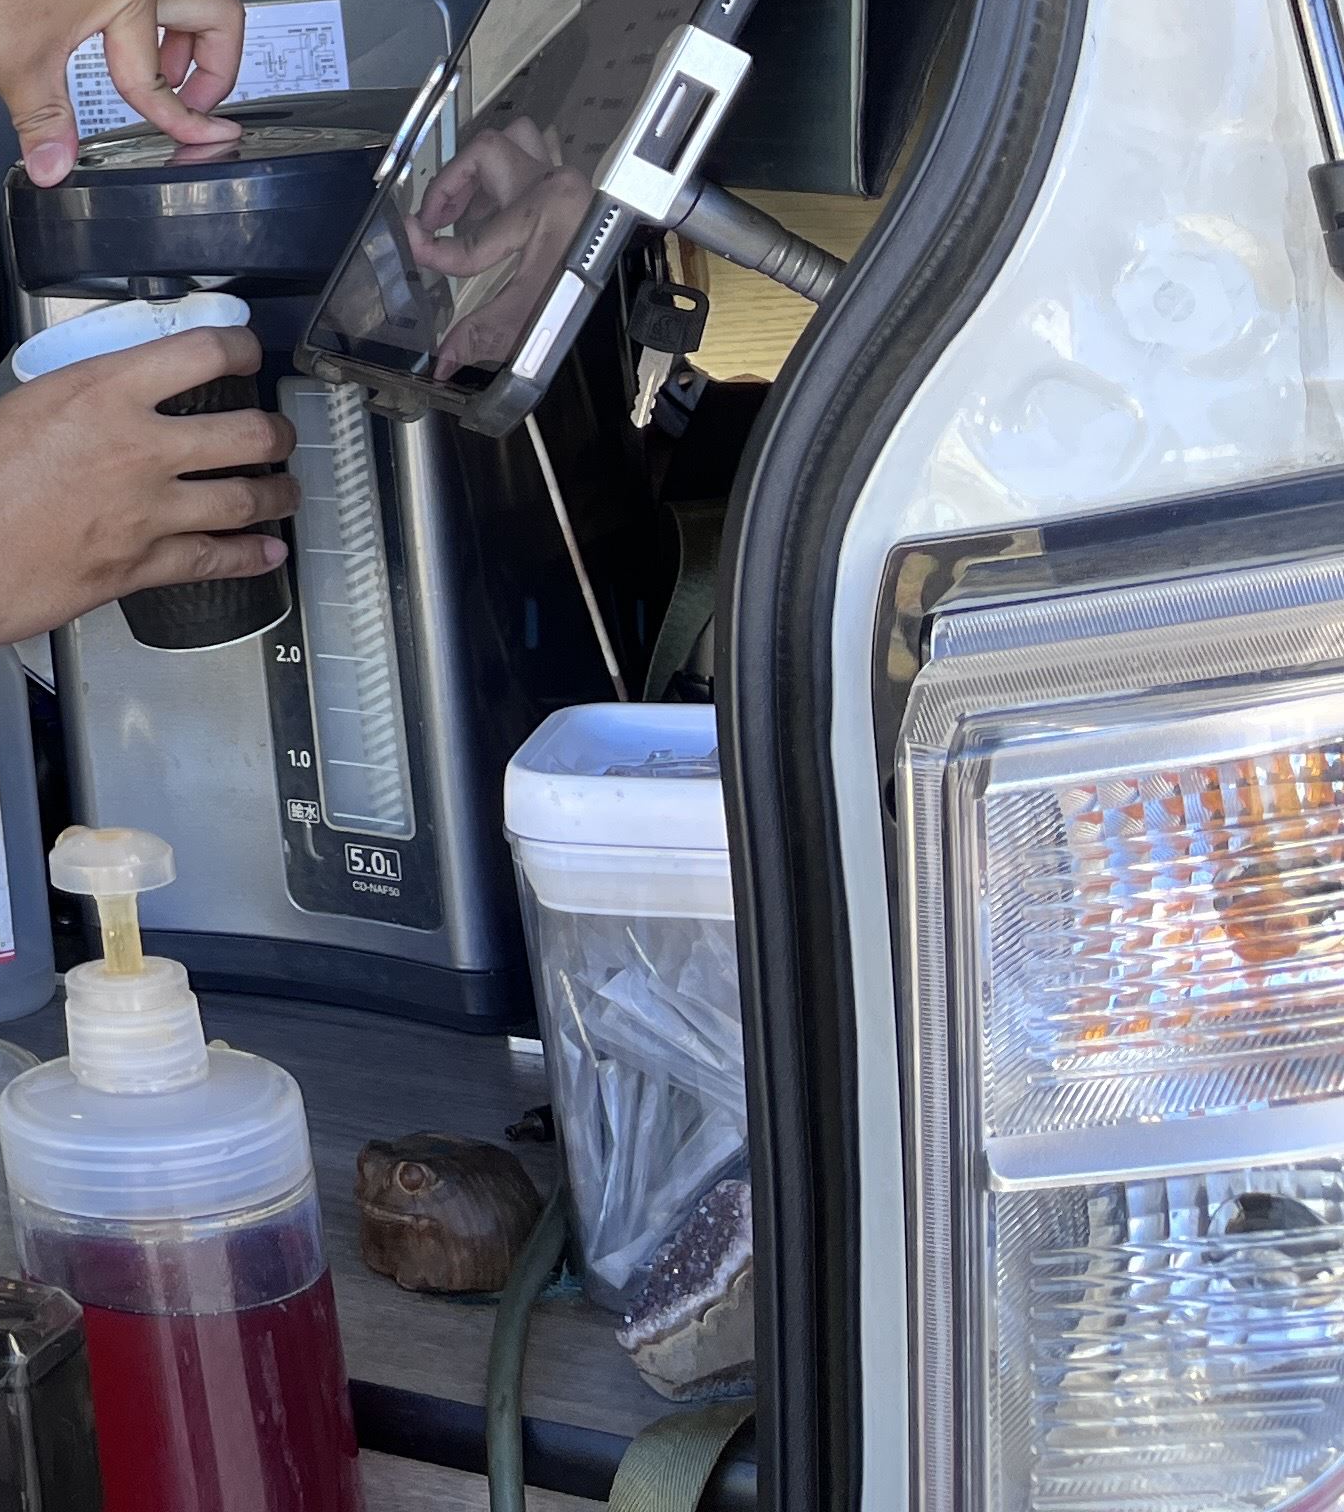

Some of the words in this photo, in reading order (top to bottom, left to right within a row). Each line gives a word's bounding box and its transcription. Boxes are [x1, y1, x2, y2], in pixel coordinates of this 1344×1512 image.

[275, 645, 301, 663] 2.0
[287, 749, 311, 767] 1.0
[290, 802, 318, 821] 給水
[350, 848, 398, 877] 5.0L
